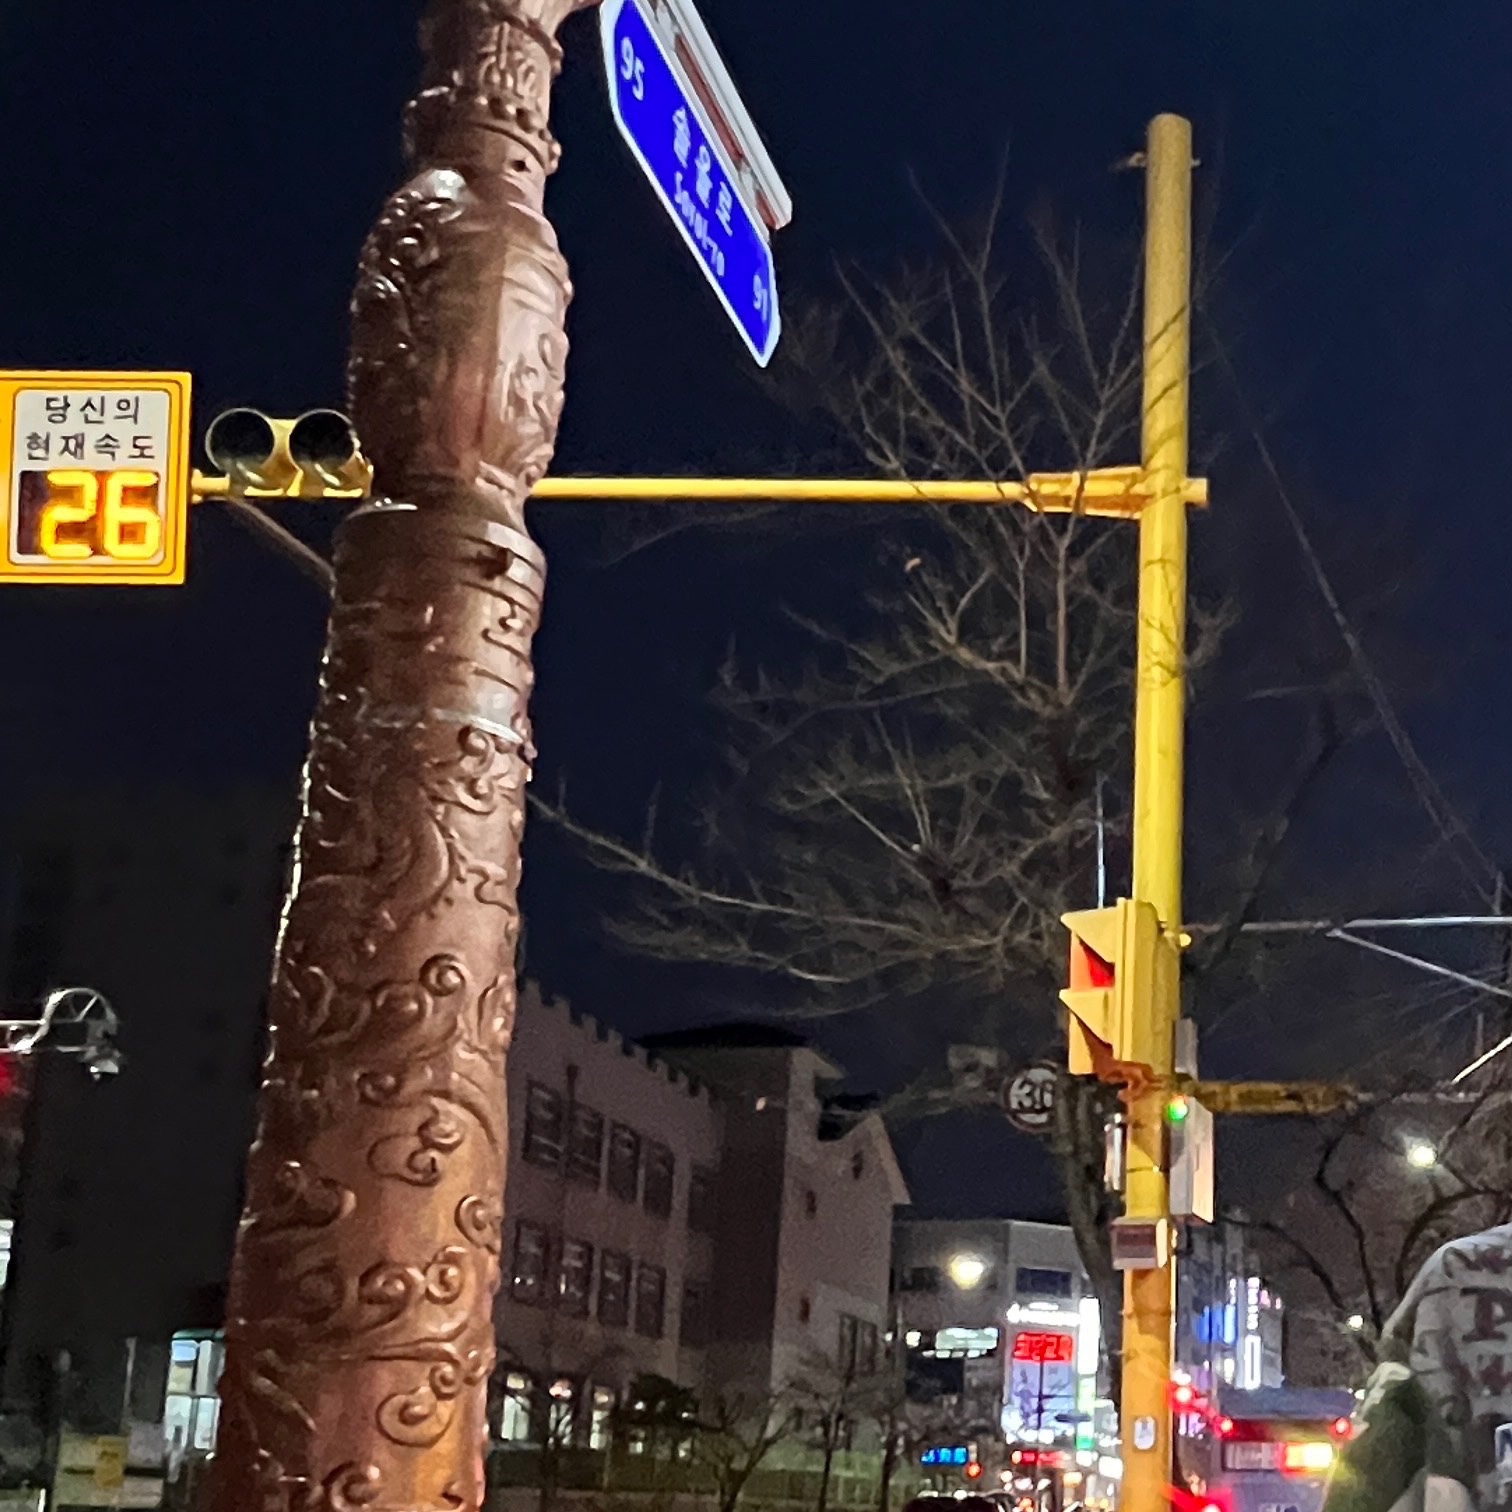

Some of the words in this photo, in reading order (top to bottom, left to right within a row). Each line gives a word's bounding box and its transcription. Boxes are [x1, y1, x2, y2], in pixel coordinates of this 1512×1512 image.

[620, 36, 644, 101] 95
[753, 274, 769, 322] 91
[45, 395, 140, 425] 당신의
[26, 431, 157, 461] 현재속도
[41, 470, 161, 558] 26
